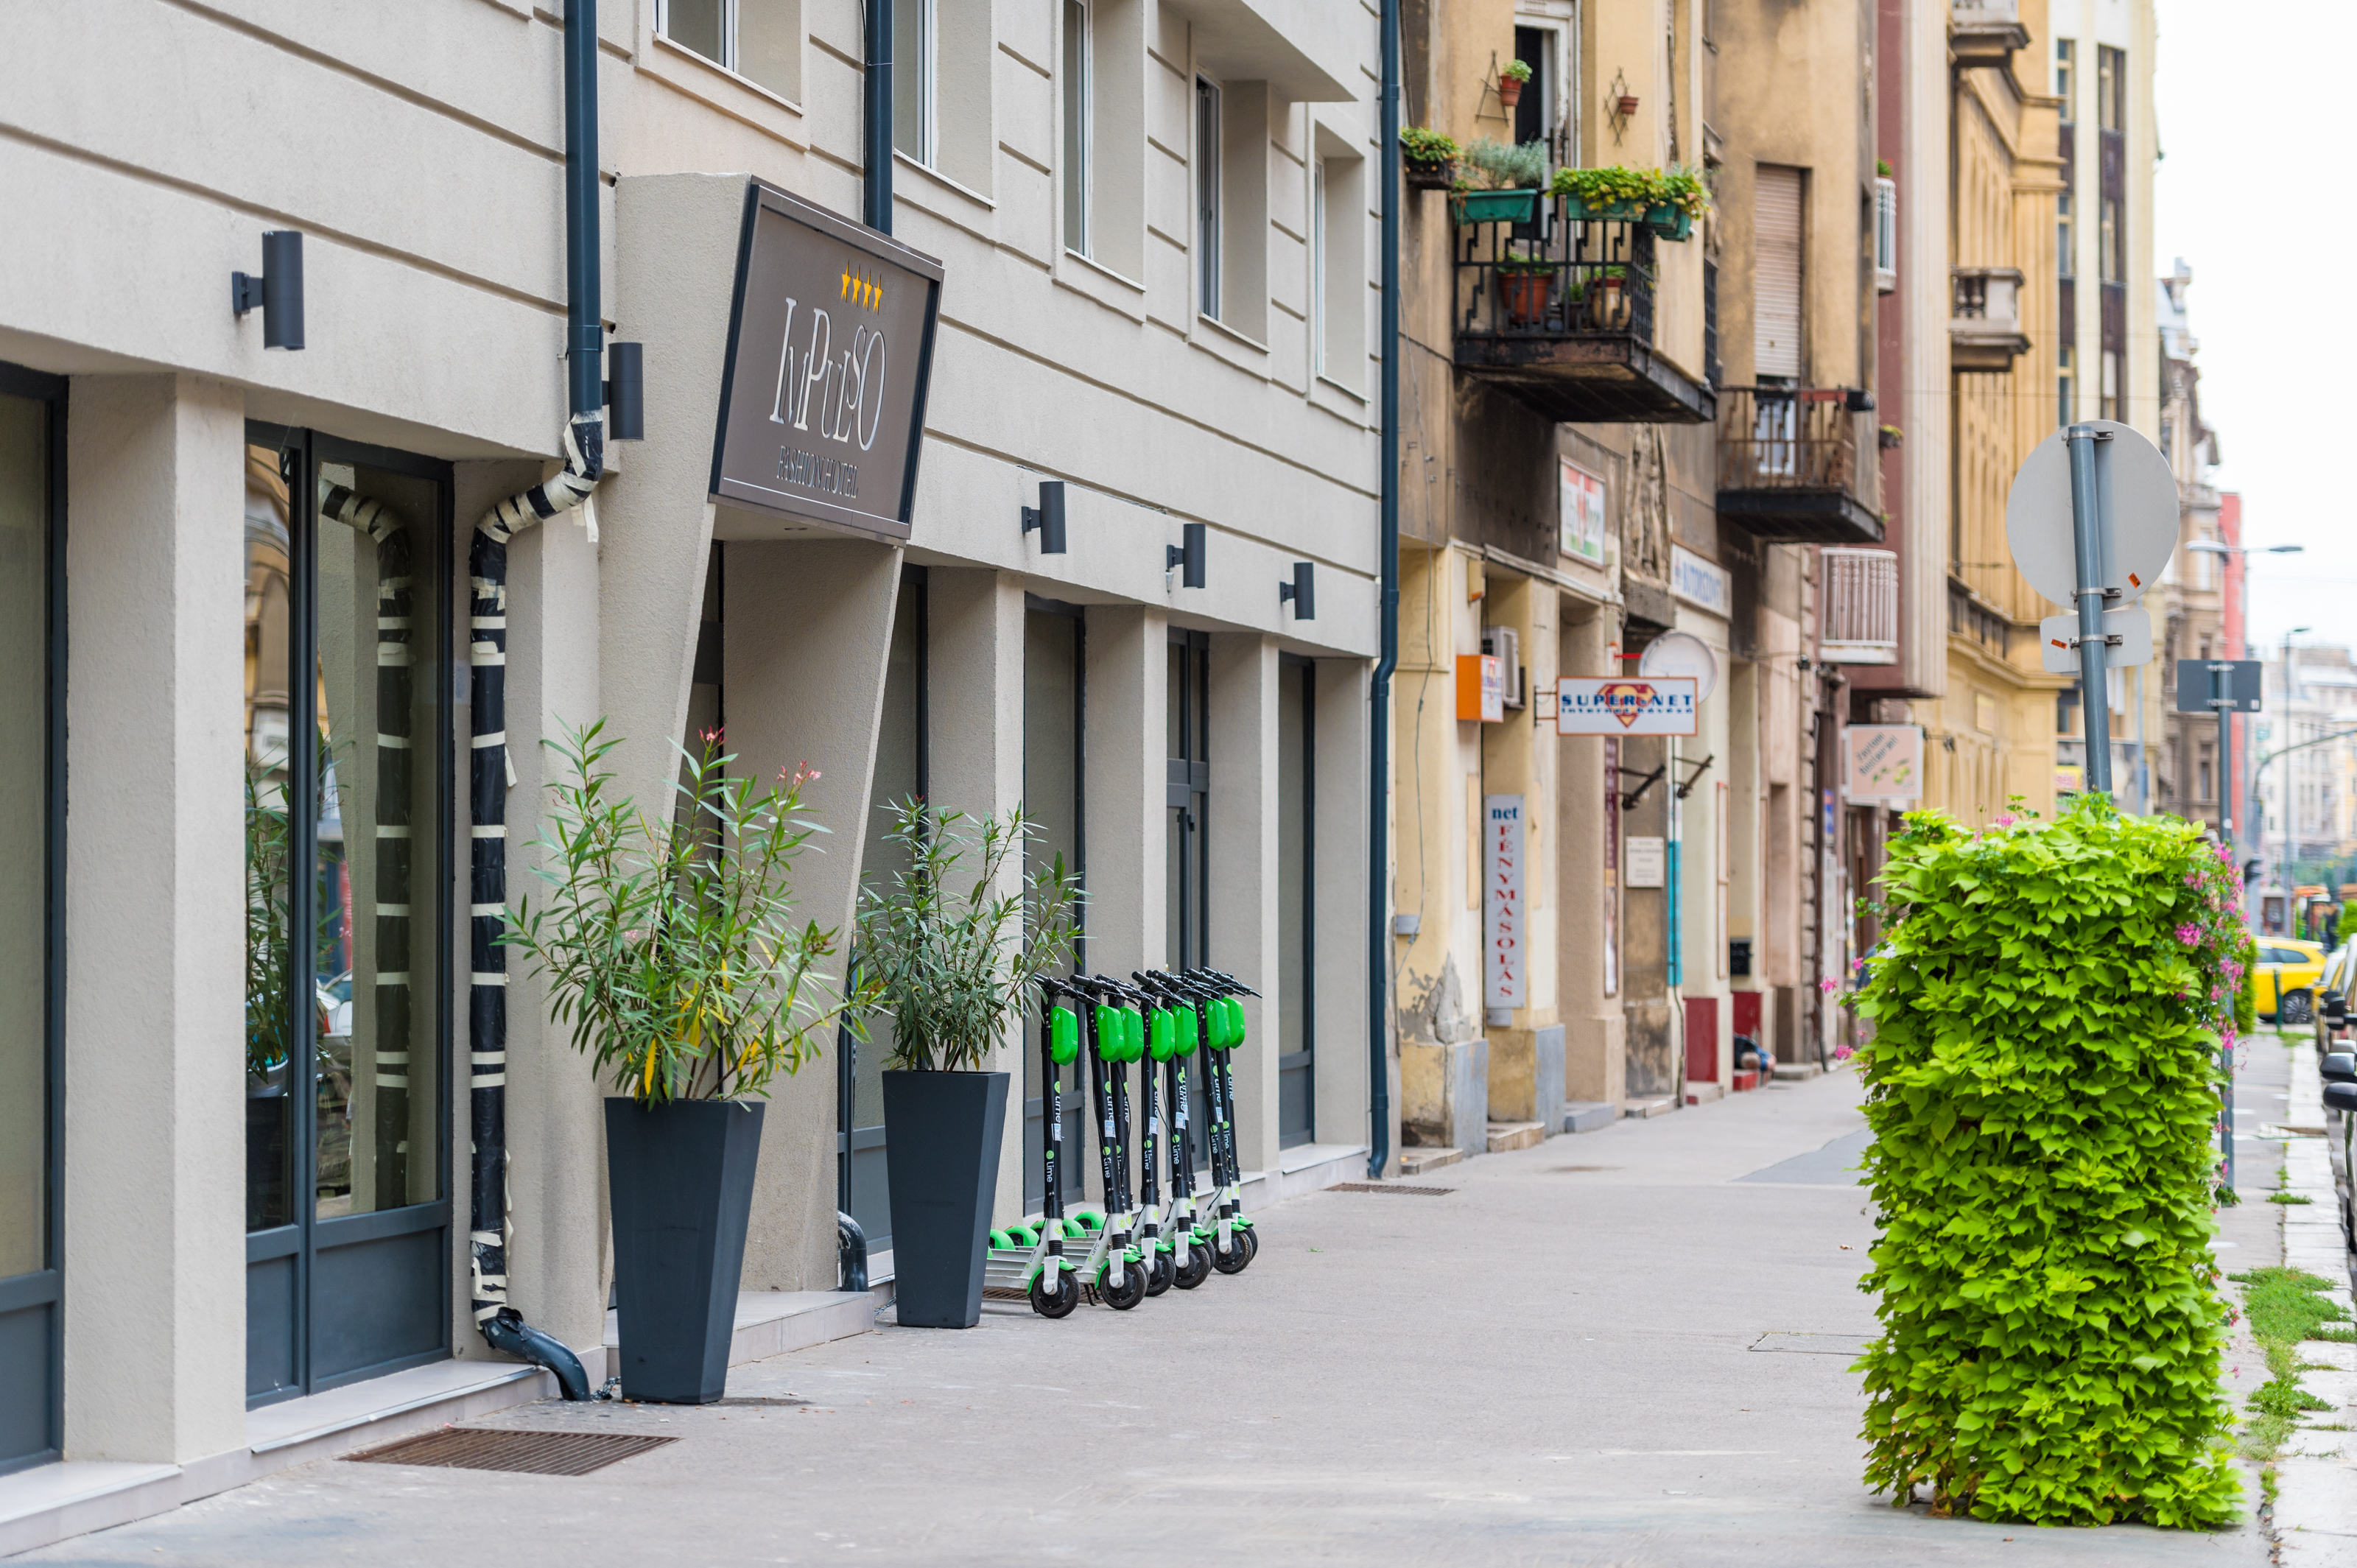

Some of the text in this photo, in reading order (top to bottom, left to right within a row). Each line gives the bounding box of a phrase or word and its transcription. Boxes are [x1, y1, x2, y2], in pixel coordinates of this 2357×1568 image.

[769, 297, 886, 451] IMPULSO
[776, 445, 859, 499] FASHION HOTEL
[1492, 806, 1519, 820] net
